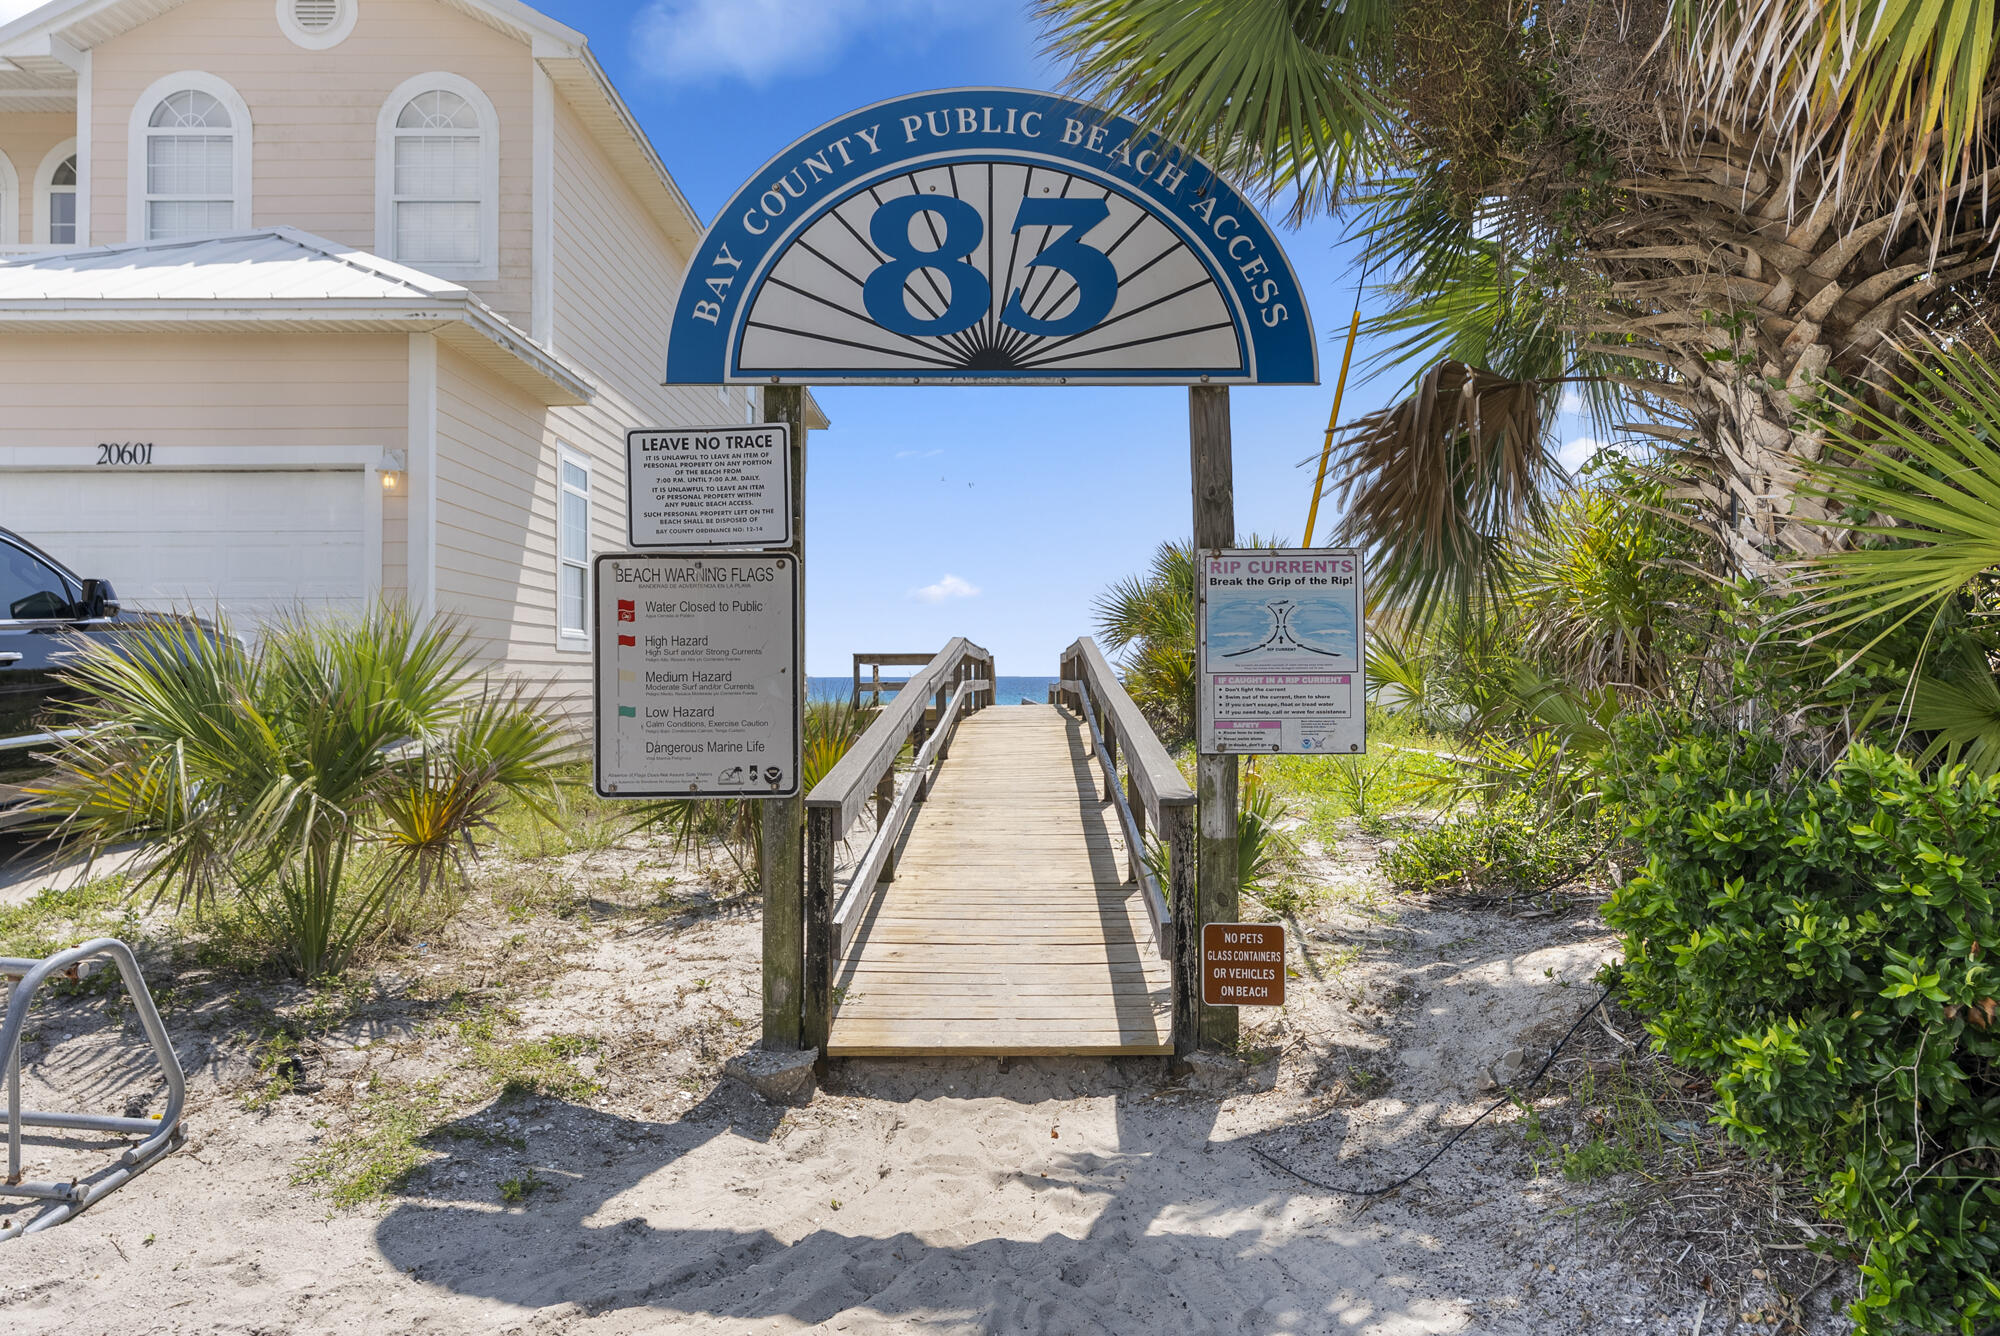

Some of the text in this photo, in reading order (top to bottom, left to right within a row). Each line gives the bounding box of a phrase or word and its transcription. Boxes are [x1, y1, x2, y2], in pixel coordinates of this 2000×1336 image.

[692, 107, 1289, 329] BAY COUNTY PUBLIC BEACH ACCESS
[862, 192, 1118, 338] 83
[642, 435, 772, 451] LEAVE NO TRACE
[96, 441, 153, 465] 20601
[1210, 560, 1353, 574] RIP CURRENTS
[616, 567, 774, 582] BEACH WARNING FLAGS
[1210, 577, 1243, 586] Break
[1268, 577, 1291, 586] Grip
[1332, 576, 1353, 586] Rip!
[646, 600, 763, 612] Water Closed to Public
[645, 636, 708, 649] High Hazard
[646, 649, 662, 657] High
[706, 648, 729, 657] Strong
[646, 671, 732, 682] Medium Hazard
[646, 706, 714, 718] Low Hazard
[646, 740, 765, 755] Dangerous Marine Life
[1224, 933, 1264, 944] NO PETS
[1208, 951, 1281, 962] GLASS CONTAINERS
[1214, 968, 1275, 980] OR VEHICLES
[1221, 986, 1268, 997] ON BEACH
